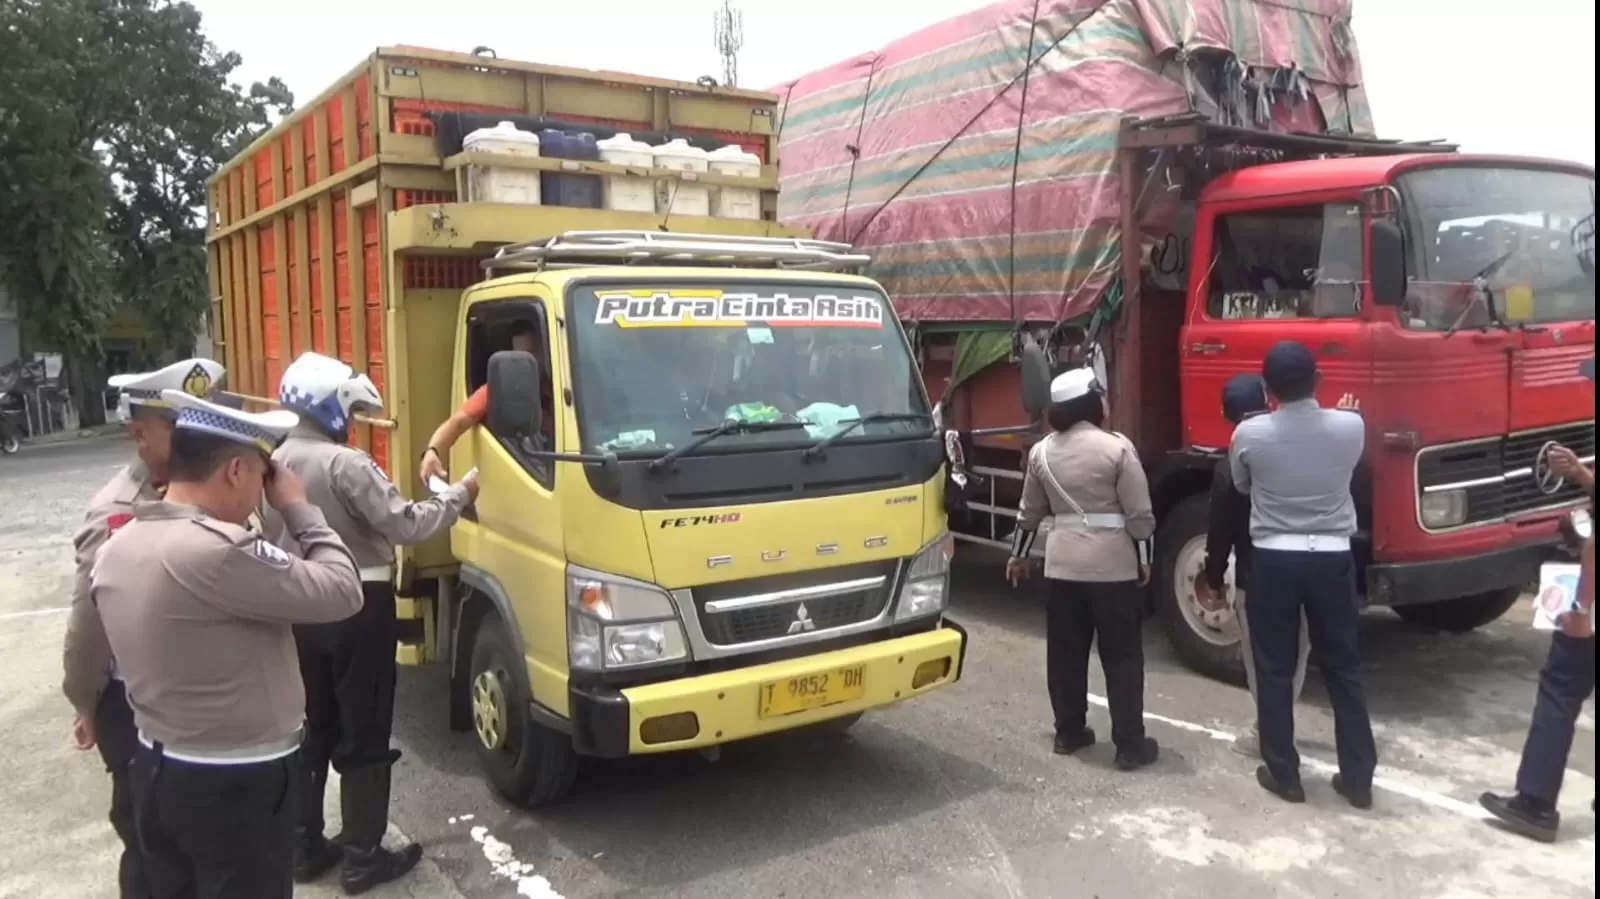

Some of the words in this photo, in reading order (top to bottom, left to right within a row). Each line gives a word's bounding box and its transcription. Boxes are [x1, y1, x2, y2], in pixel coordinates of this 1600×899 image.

[598, 294, 711, 320] Putra
[721, 295, 810, 319] Cinta
[815, 296, 881, 320] Asih
[706, 535, 888, 568] FUSO
